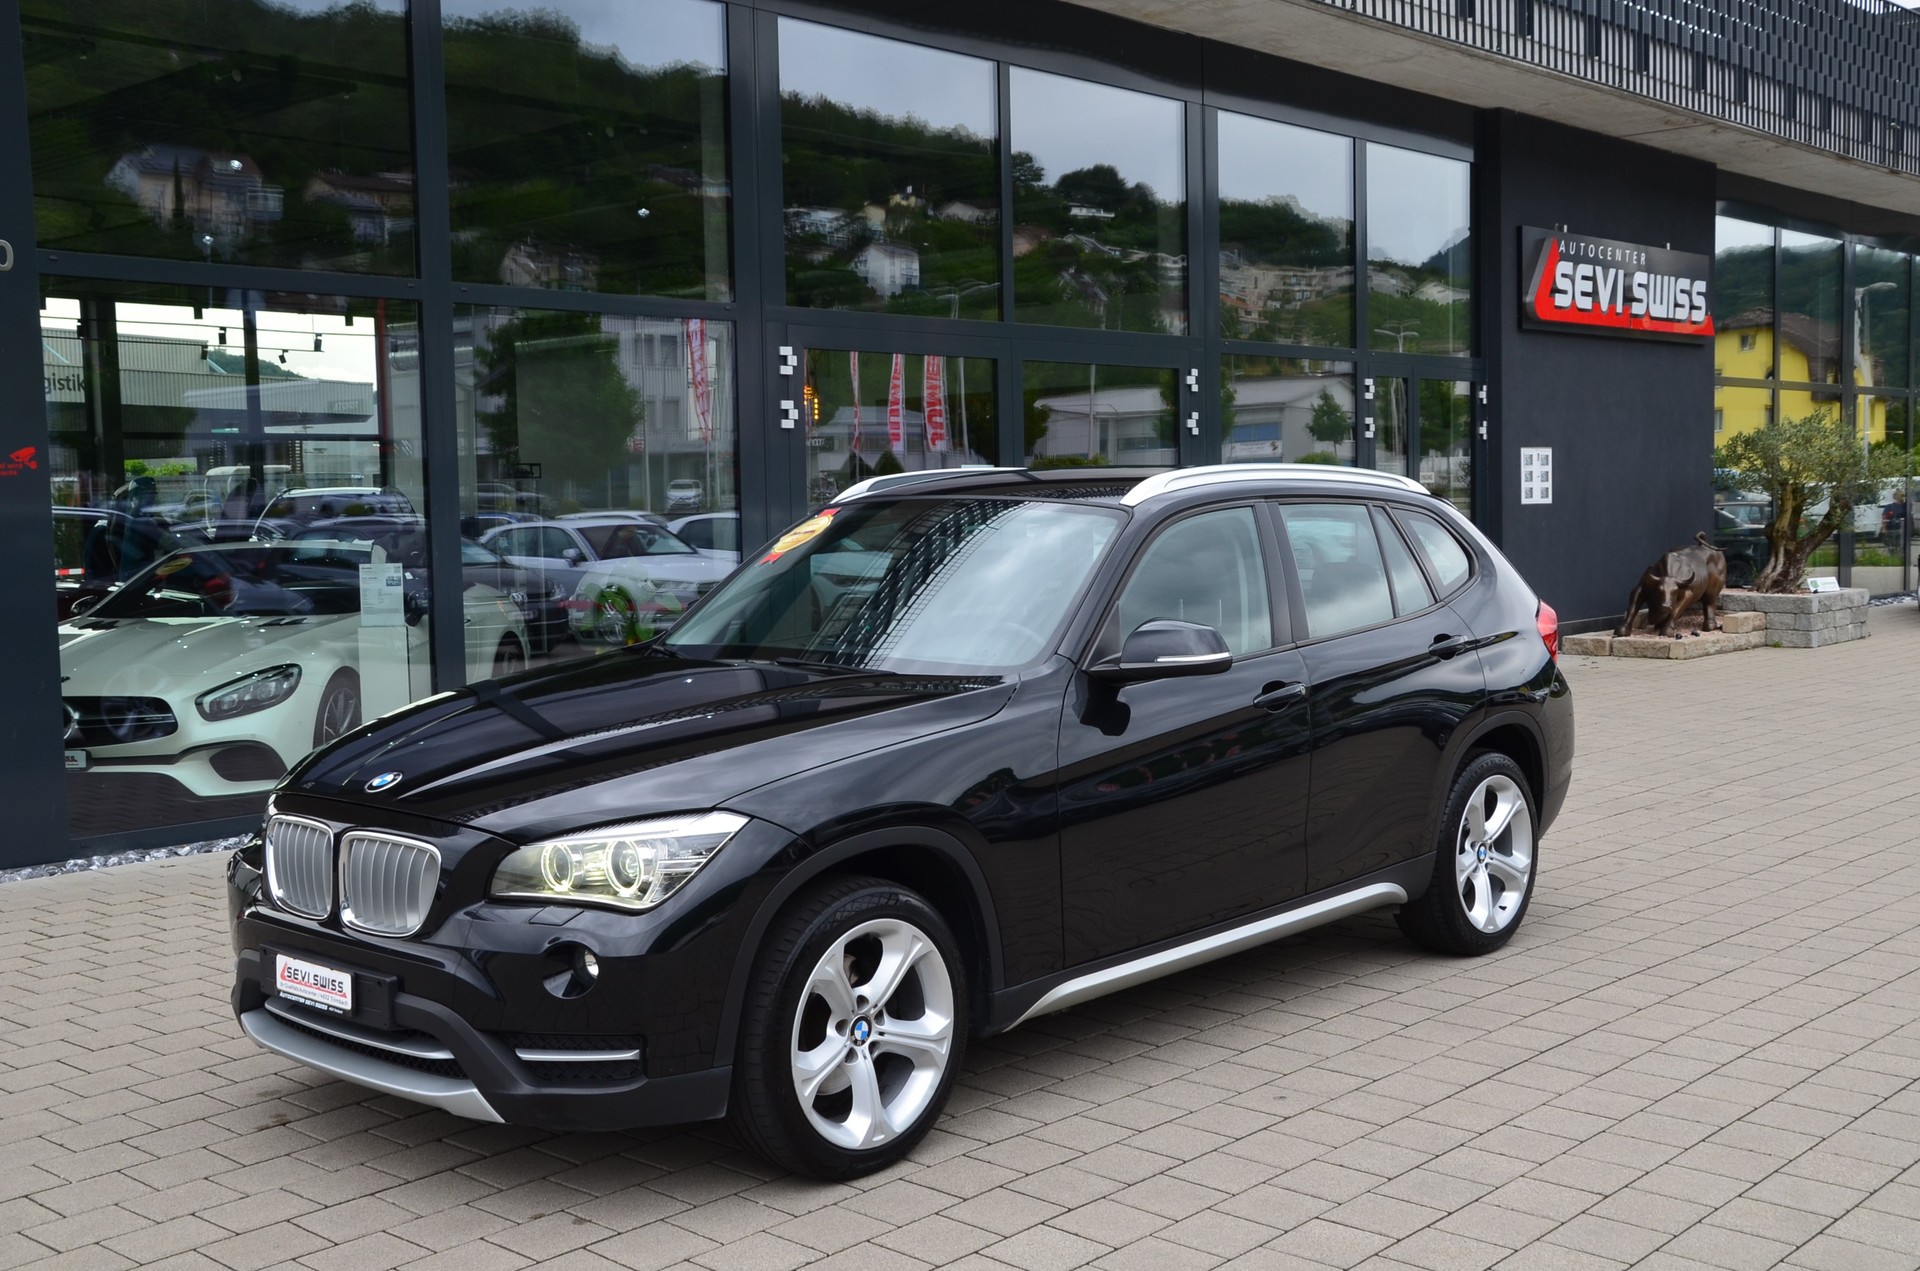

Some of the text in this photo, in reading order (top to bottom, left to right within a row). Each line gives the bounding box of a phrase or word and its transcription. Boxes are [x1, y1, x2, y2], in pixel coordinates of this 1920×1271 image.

[1559, 240, 1646, 265] AUTOCENTER
[1554, 260, 1707, 322] SEVI SWISS
[286, 966, 344, 994] SEVI SWISS
